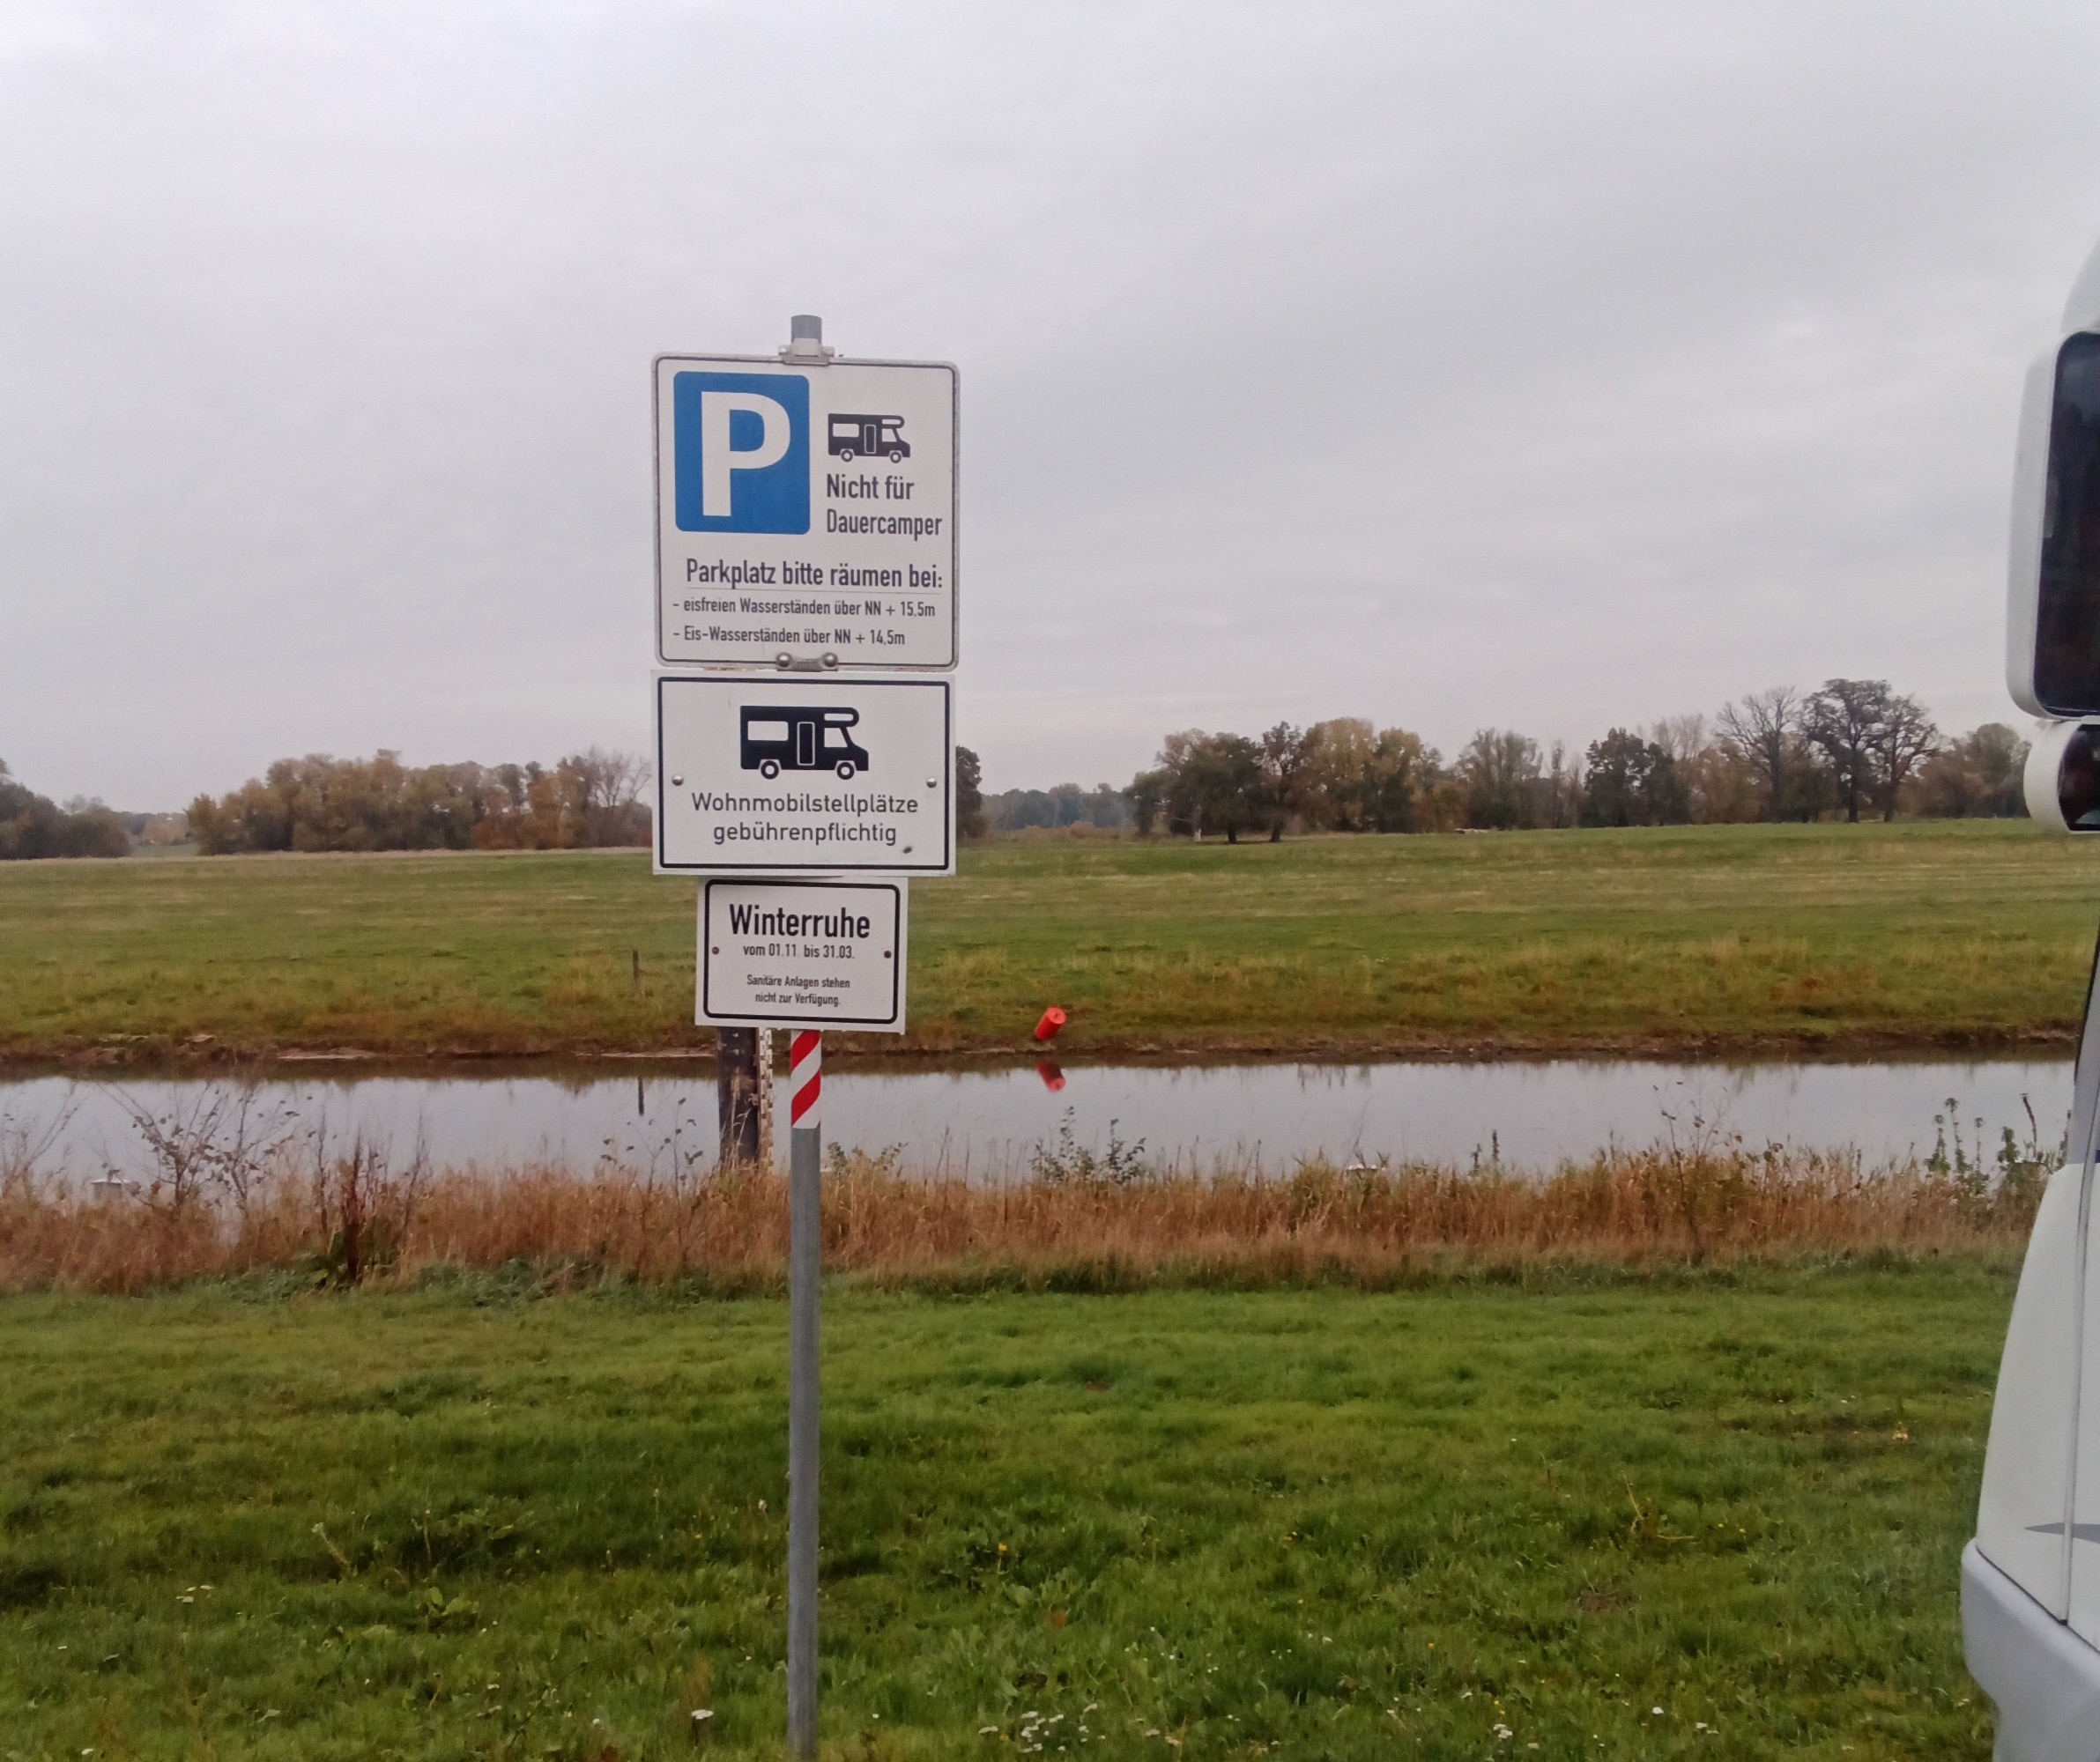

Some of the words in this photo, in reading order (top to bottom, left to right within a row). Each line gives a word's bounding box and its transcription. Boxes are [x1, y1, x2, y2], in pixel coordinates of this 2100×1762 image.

[701, 391, 790, 516] P
[827, 473, 879, 499] Nicht
[885, 475, 915, 500] für
[827, 508, 943, 541] Dauercamper
[686, 558, 776, 589] Parkplatz
[783, 560, 823, 585] bitte
[830, 563, 902, 587] räumen
[909, 564, 942, 588] bei:
[684, 596, 736, 612] eisfreien
[739, 597, 830, 615] Wasserständen
[835, 599, 862, 615] über
[864, 601, 881, 616] NN
[886, 604, 896, 616] +
[901, 601, 936, 617] 15.5m
[684, 625, 800, 643] Eis-Wasserständen
[804, 627, 831, 644] über
[834, 629, 851, 644] NN
[855, 633, 865, 644] +
[870, 629, 905, 645] 14.5m
[692, 792, 918, 817] Wohnmobilstellplätze
[713, 821, 896, 846] gebührenpflichtig
[729, 904, 871, 938] Winterruhe
[743, 945, 766, 956] vom
[804, 944, 820, 958] bis
[823, 945, 856, 959] 31.03.
[746, 974, 783, 987] Sanitäre
[784, 976, 820, 989] Anlagen
[821, 977, 850, 988] stehen
[755, 993, 777, 1003] nicht
[778, 995, 793, 1003] zur
